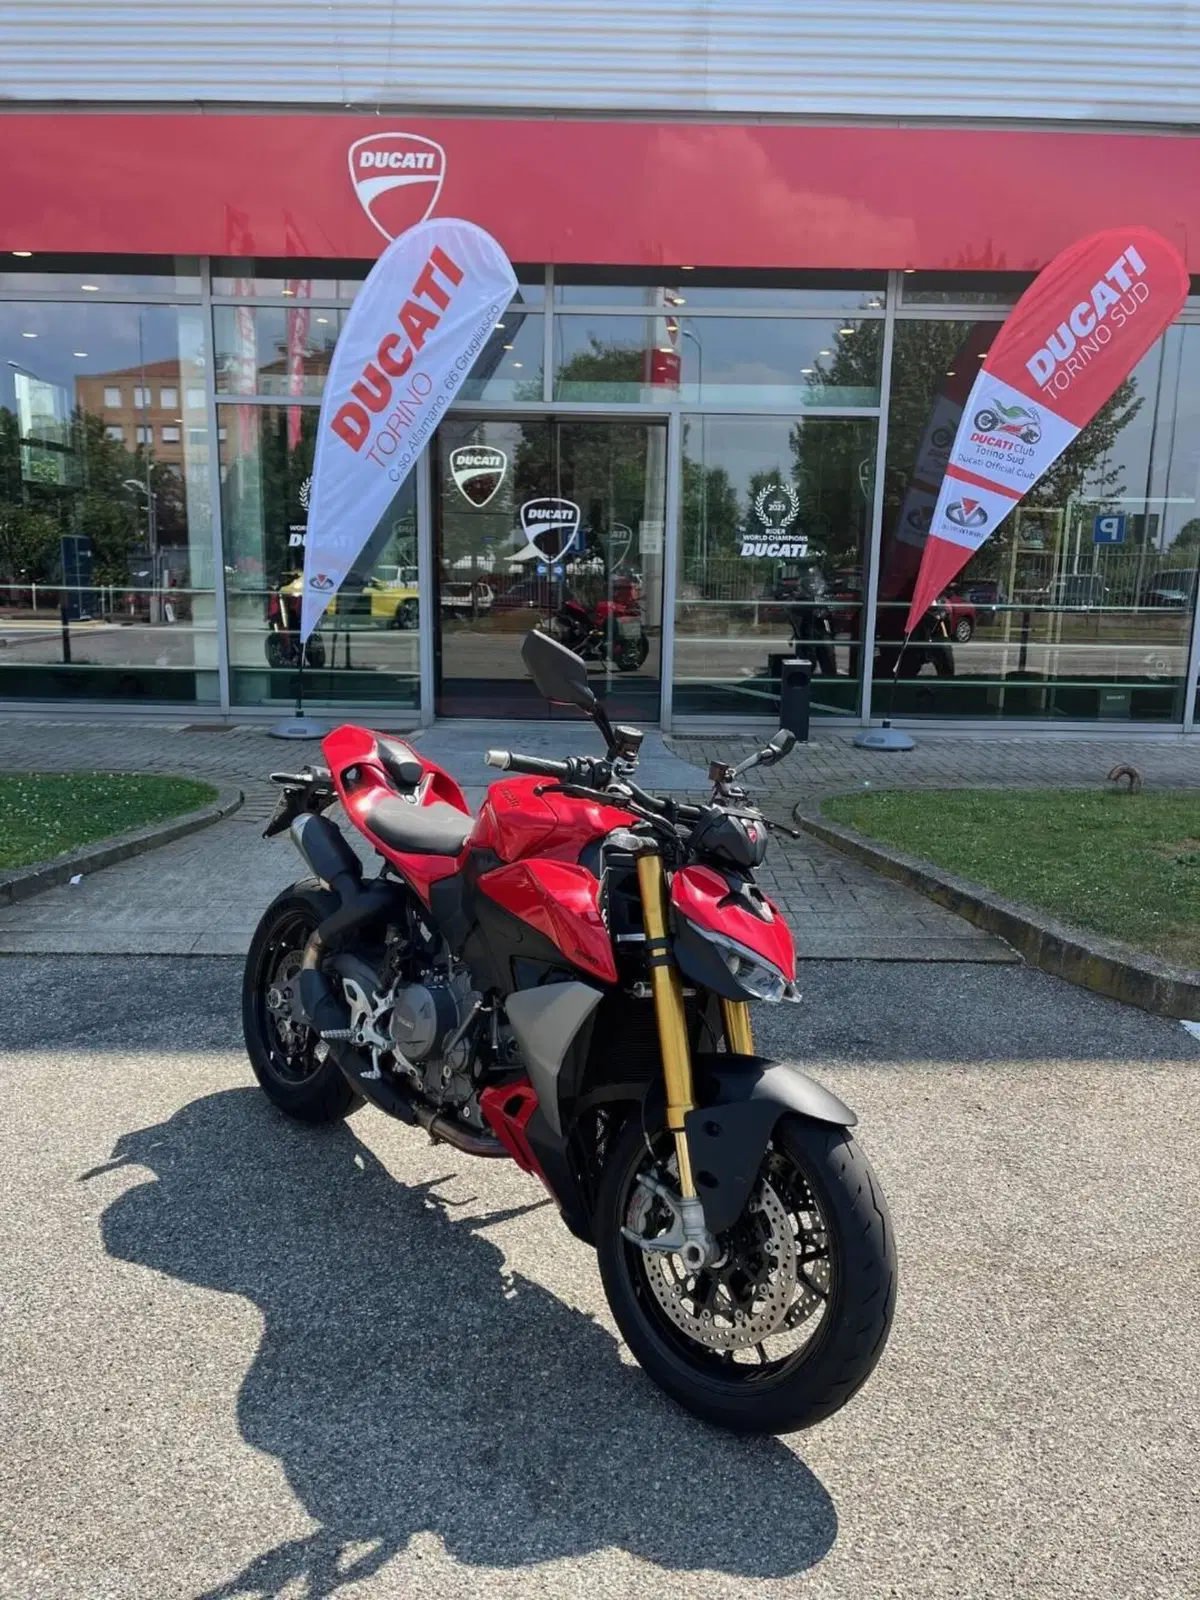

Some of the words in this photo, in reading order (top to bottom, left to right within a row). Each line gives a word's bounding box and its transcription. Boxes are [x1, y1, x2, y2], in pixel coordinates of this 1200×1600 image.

[359, 151, 435, 169] DUCATI
[1025, 244, 1147, 388] DUCATI
[329, 244, 465, 453] DUCATI
[443, 371, 460, 391] 66
[457, 303, 500, 372] Grugliasco
[1042, 324, 1112, 400] TORINO
[1110, 281, 1150, 328] SUD
[364, 372, 433, 469] TORINO
[970, 432, 1014, 451] DUCATI
[1013, 443, 1035, 457] Club
[975, 444, 1005, 460] Torino
[1006, 454, 1025, 465] Sud
[456, 455, 501, 466] DUCATI
[957, 453, 983, 466] Ducati
[985, 460, 1015, 475] Official
[1016, 469, 1036, 480] Club
[527, 508, 574, 520] DUCATI
[740, 542, 808, 558] DUCATI
